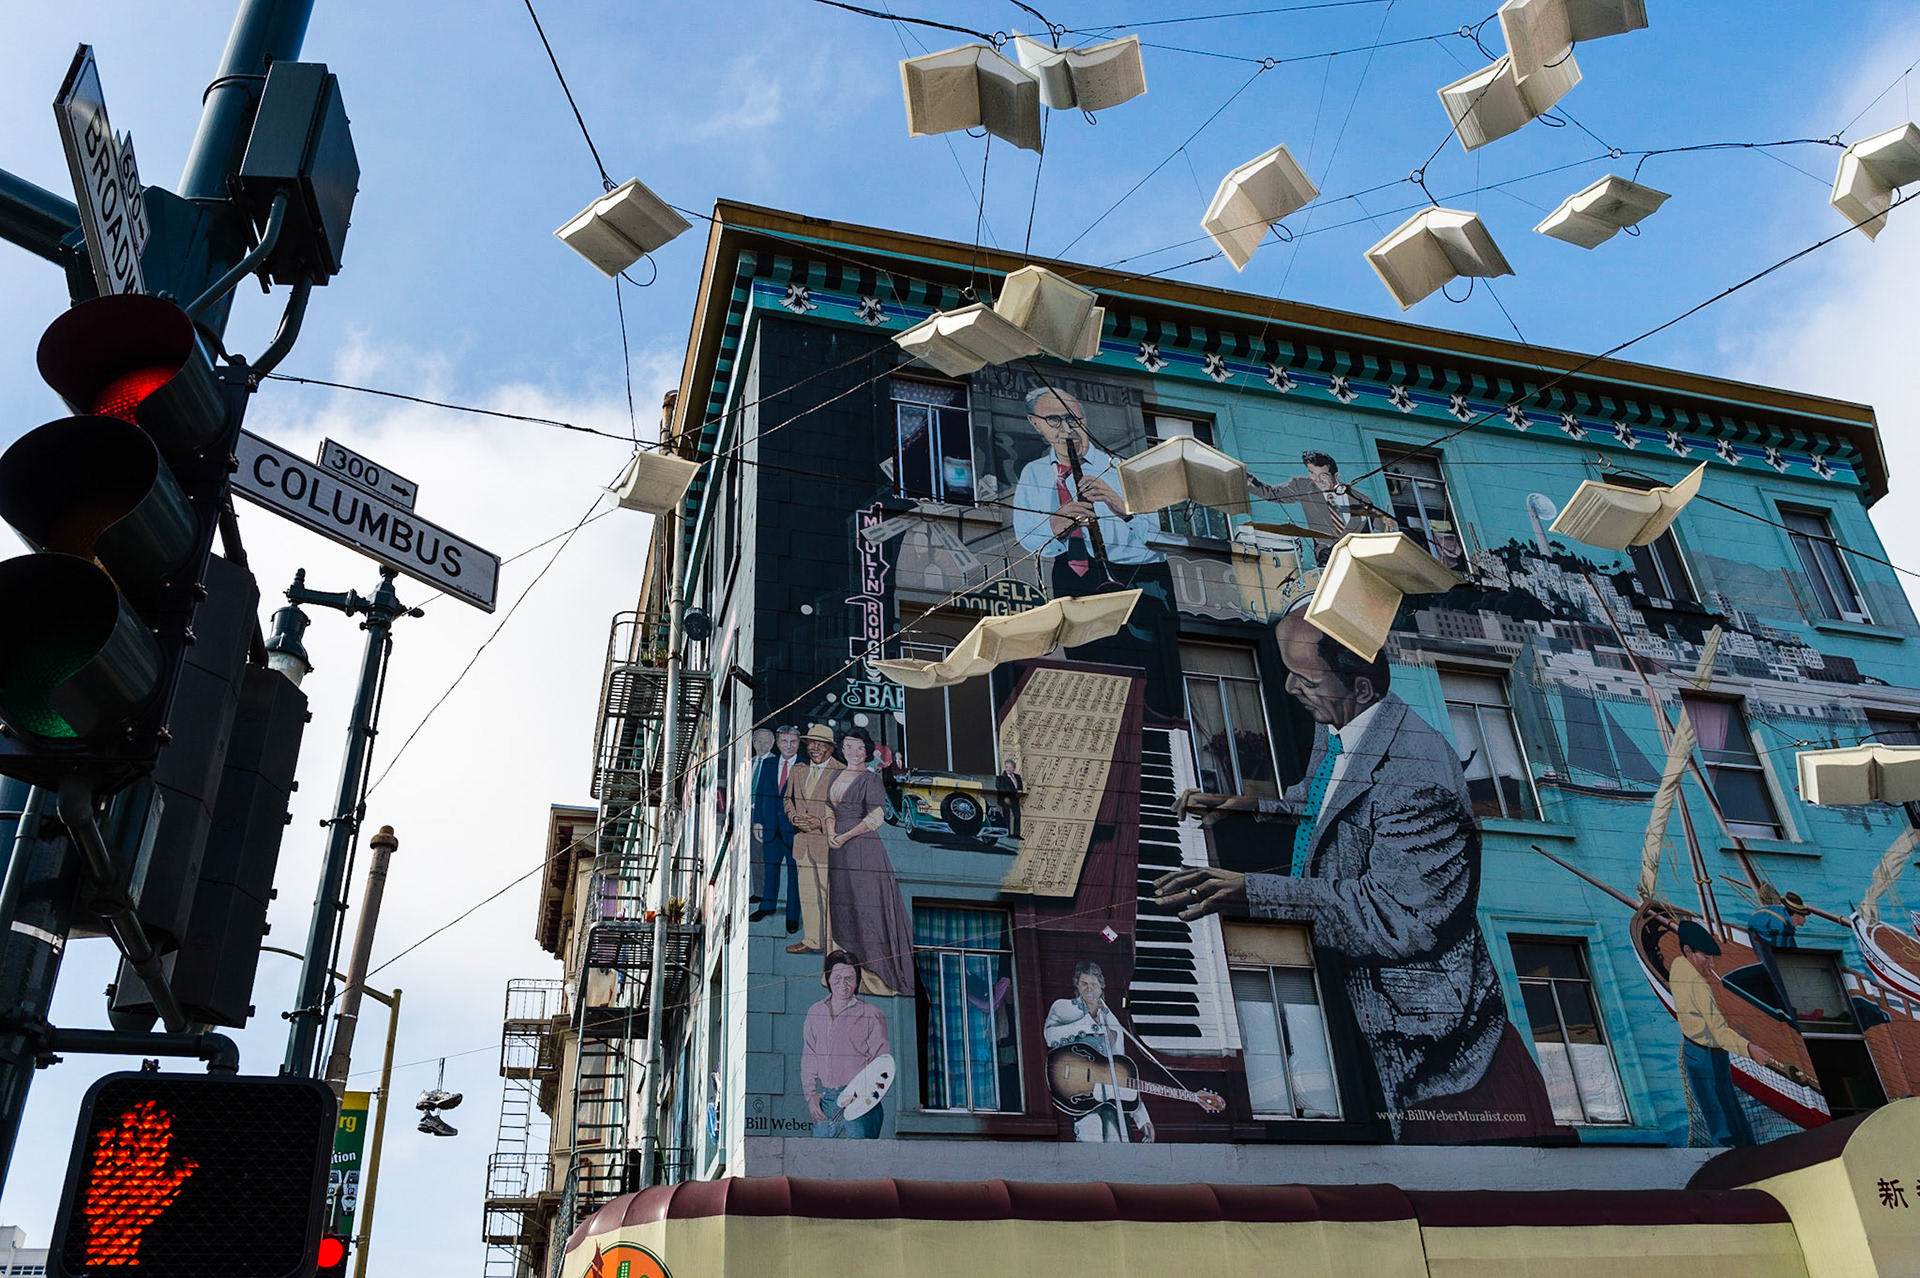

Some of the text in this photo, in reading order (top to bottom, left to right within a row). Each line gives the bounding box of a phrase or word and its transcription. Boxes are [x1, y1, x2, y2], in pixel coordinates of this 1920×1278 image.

[123, 153, 142, 221] 600
[1080, 382, 1141, 406] HOTEL
[331, 449, 380, 487] 300
[253, 453, 462, 578] COLUMBUS
[339, 1116, 357, 1133] rg
[745, 1117, 813, 1131] Bill Weber
[1376, 1109, 1527, 1122] www.BillWeberMuralist.com
[1877, 1177, 1920, 1209] 新
